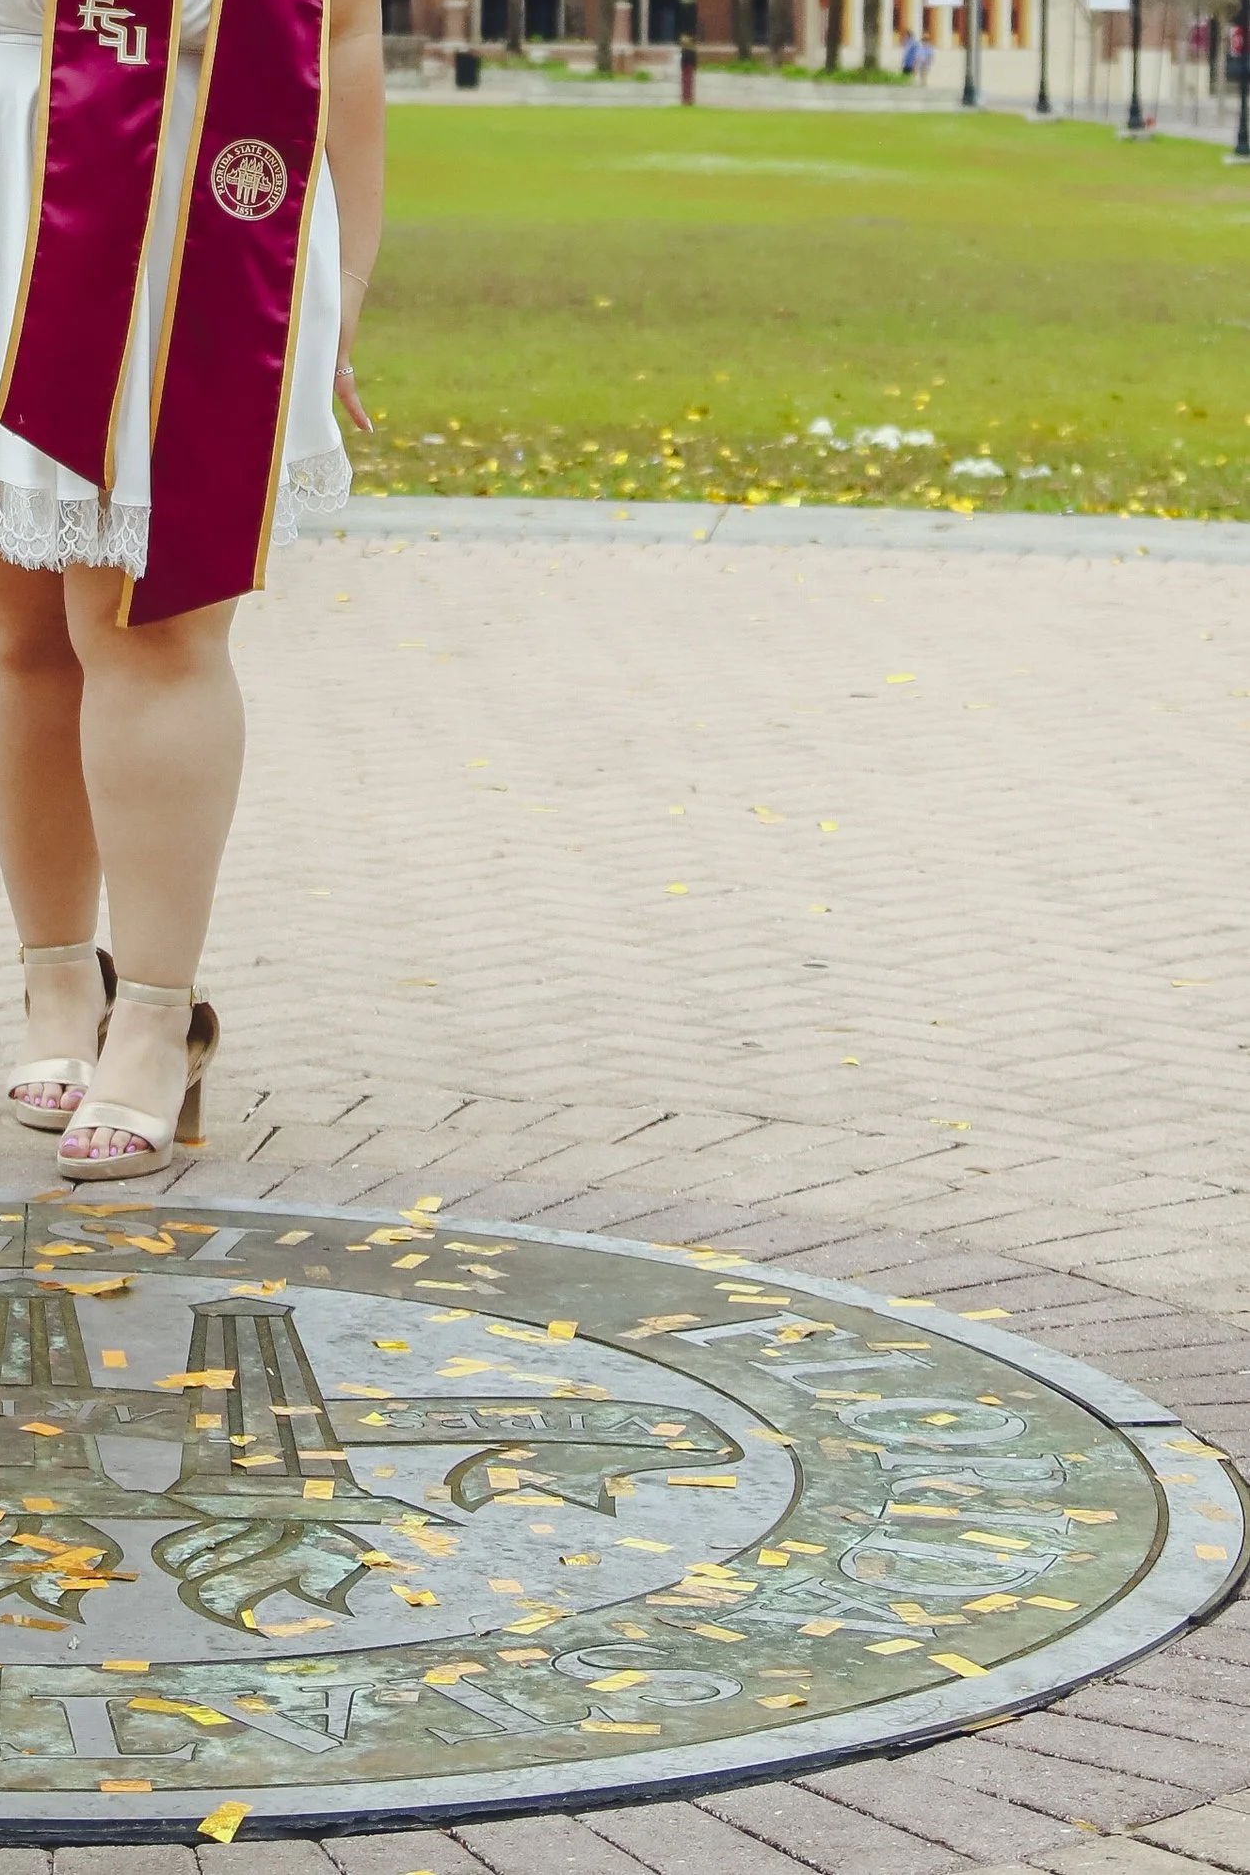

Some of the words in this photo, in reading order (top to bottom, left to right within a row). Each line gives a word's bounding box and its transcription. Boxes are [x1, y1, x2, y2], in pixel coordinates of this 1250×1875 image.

[216, 153, 234, 196] FLORIDA
[234, 144, 263, 155] STATE
[264, 151, 283, 208] UNIVERSITY
[235, 205, 254, 216] 1851
[670, 1310, 1071, 1638] FLORIDA
